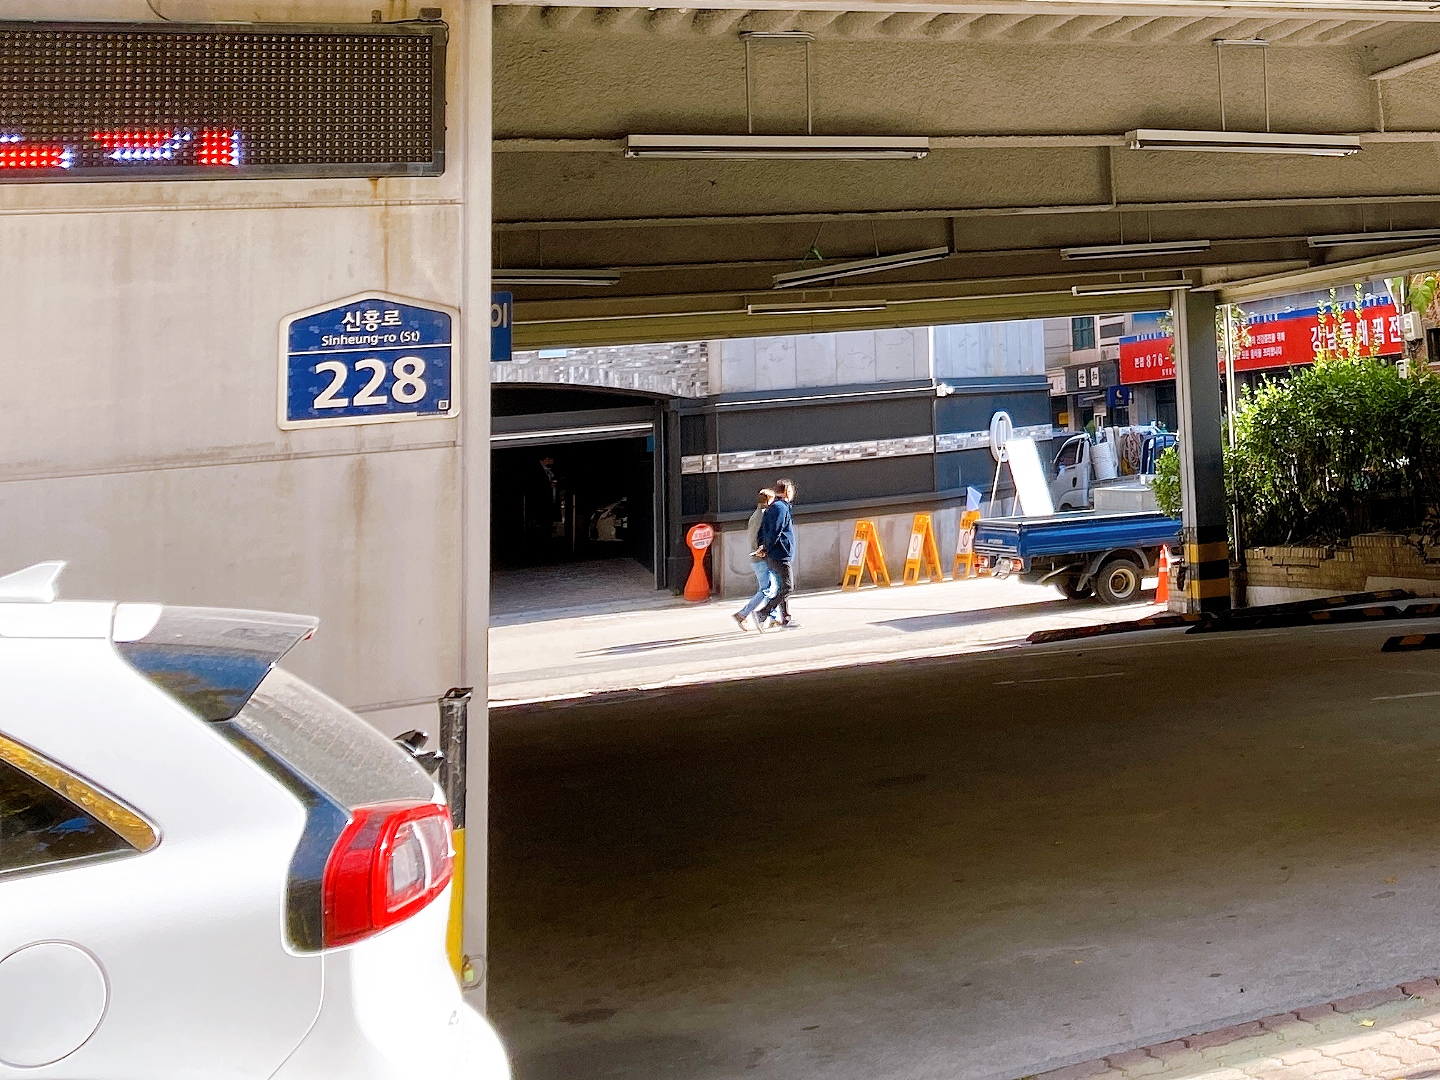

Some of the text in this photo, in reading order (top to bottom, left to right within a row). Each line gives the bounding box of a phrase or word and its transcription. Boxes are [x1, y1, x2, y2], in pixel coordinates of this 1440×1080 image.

[341, 309, 402, 332] 신흥로
[321, 331, 420, 347] Sinheung-ro (St)
[1146, 353, 1175, 368] 876-
[313, 356, 427, 409] 228
